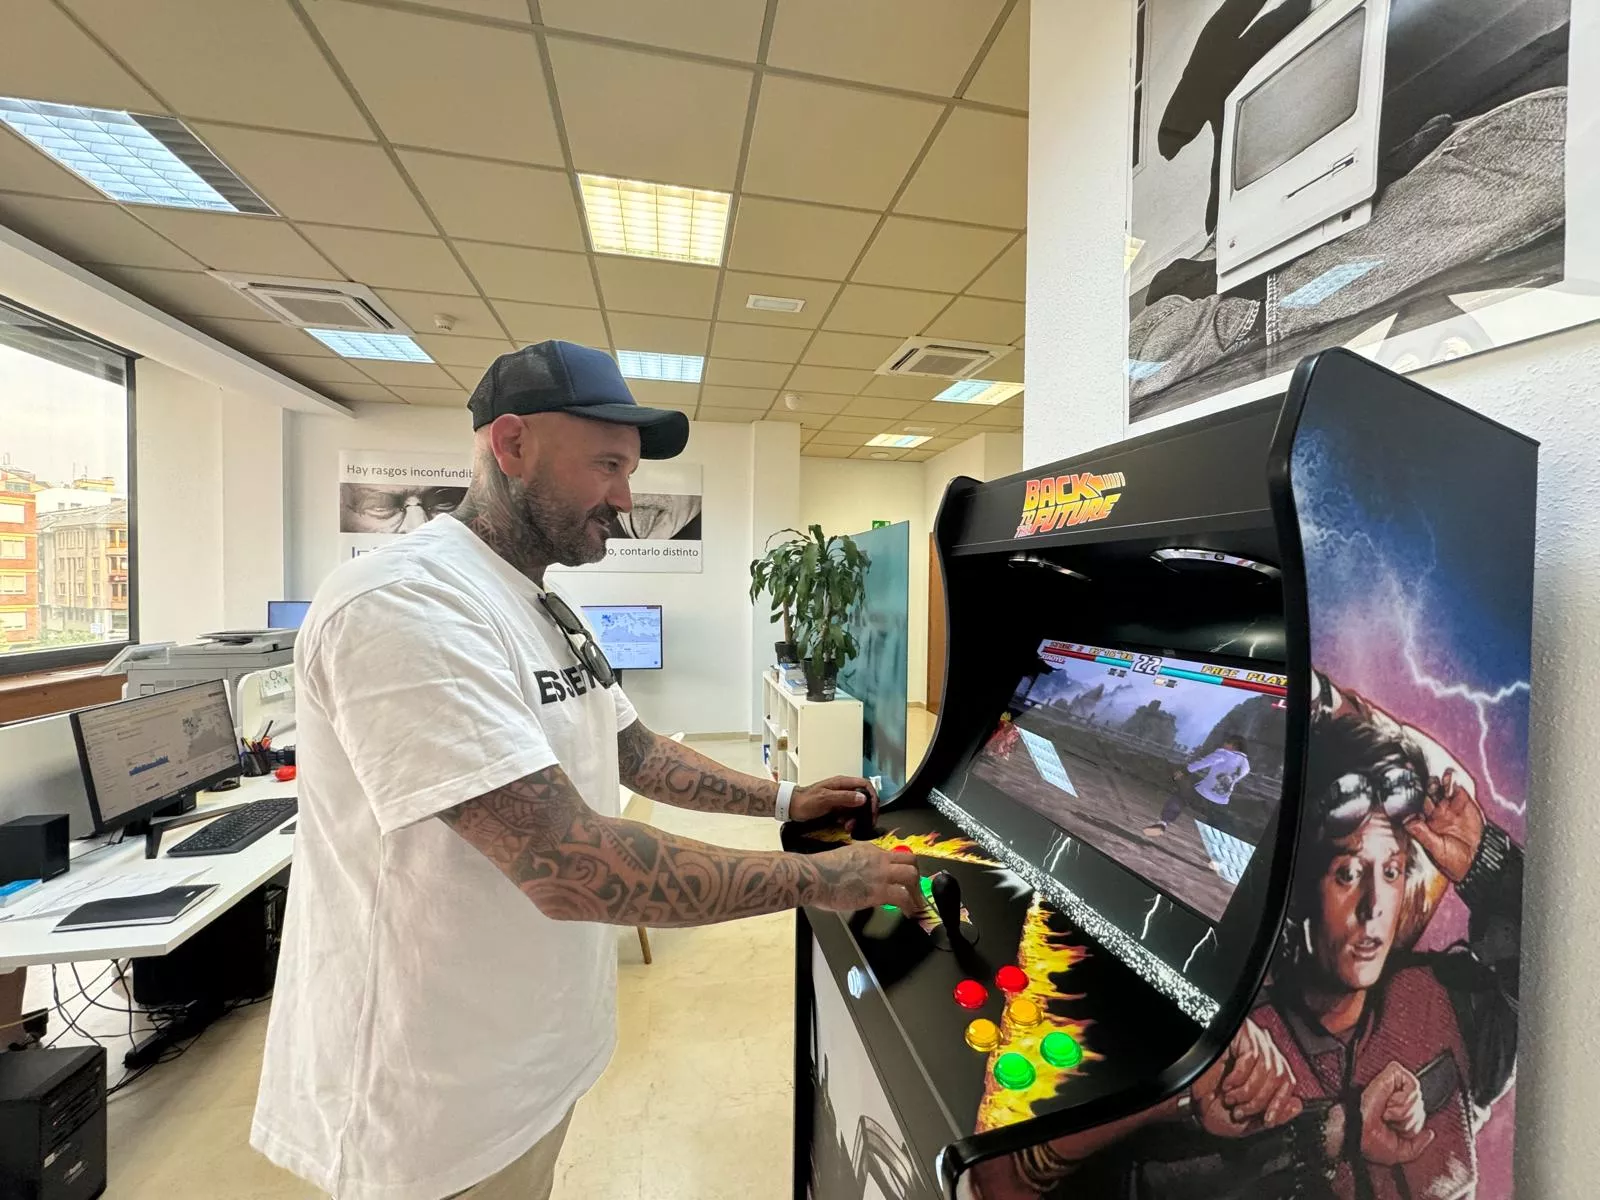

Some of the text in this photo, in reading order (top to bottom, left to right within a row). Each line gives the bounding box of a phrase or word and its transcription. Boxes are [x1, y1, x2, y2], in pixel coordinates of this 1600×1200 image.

[347, 464, 368, 476] Hay
[372, 466, 407, 477] rasgos
[1023, 472, 1101, 512] BACK
[1029, 493, 1121, 536] FUTURE
[620, 547, 660, 556] contarlo
[662, 547, 699, 556] distinto
[1132, 654, 1162, 676] 22
[1201, 664, 1288, 686] FREE PLAY
